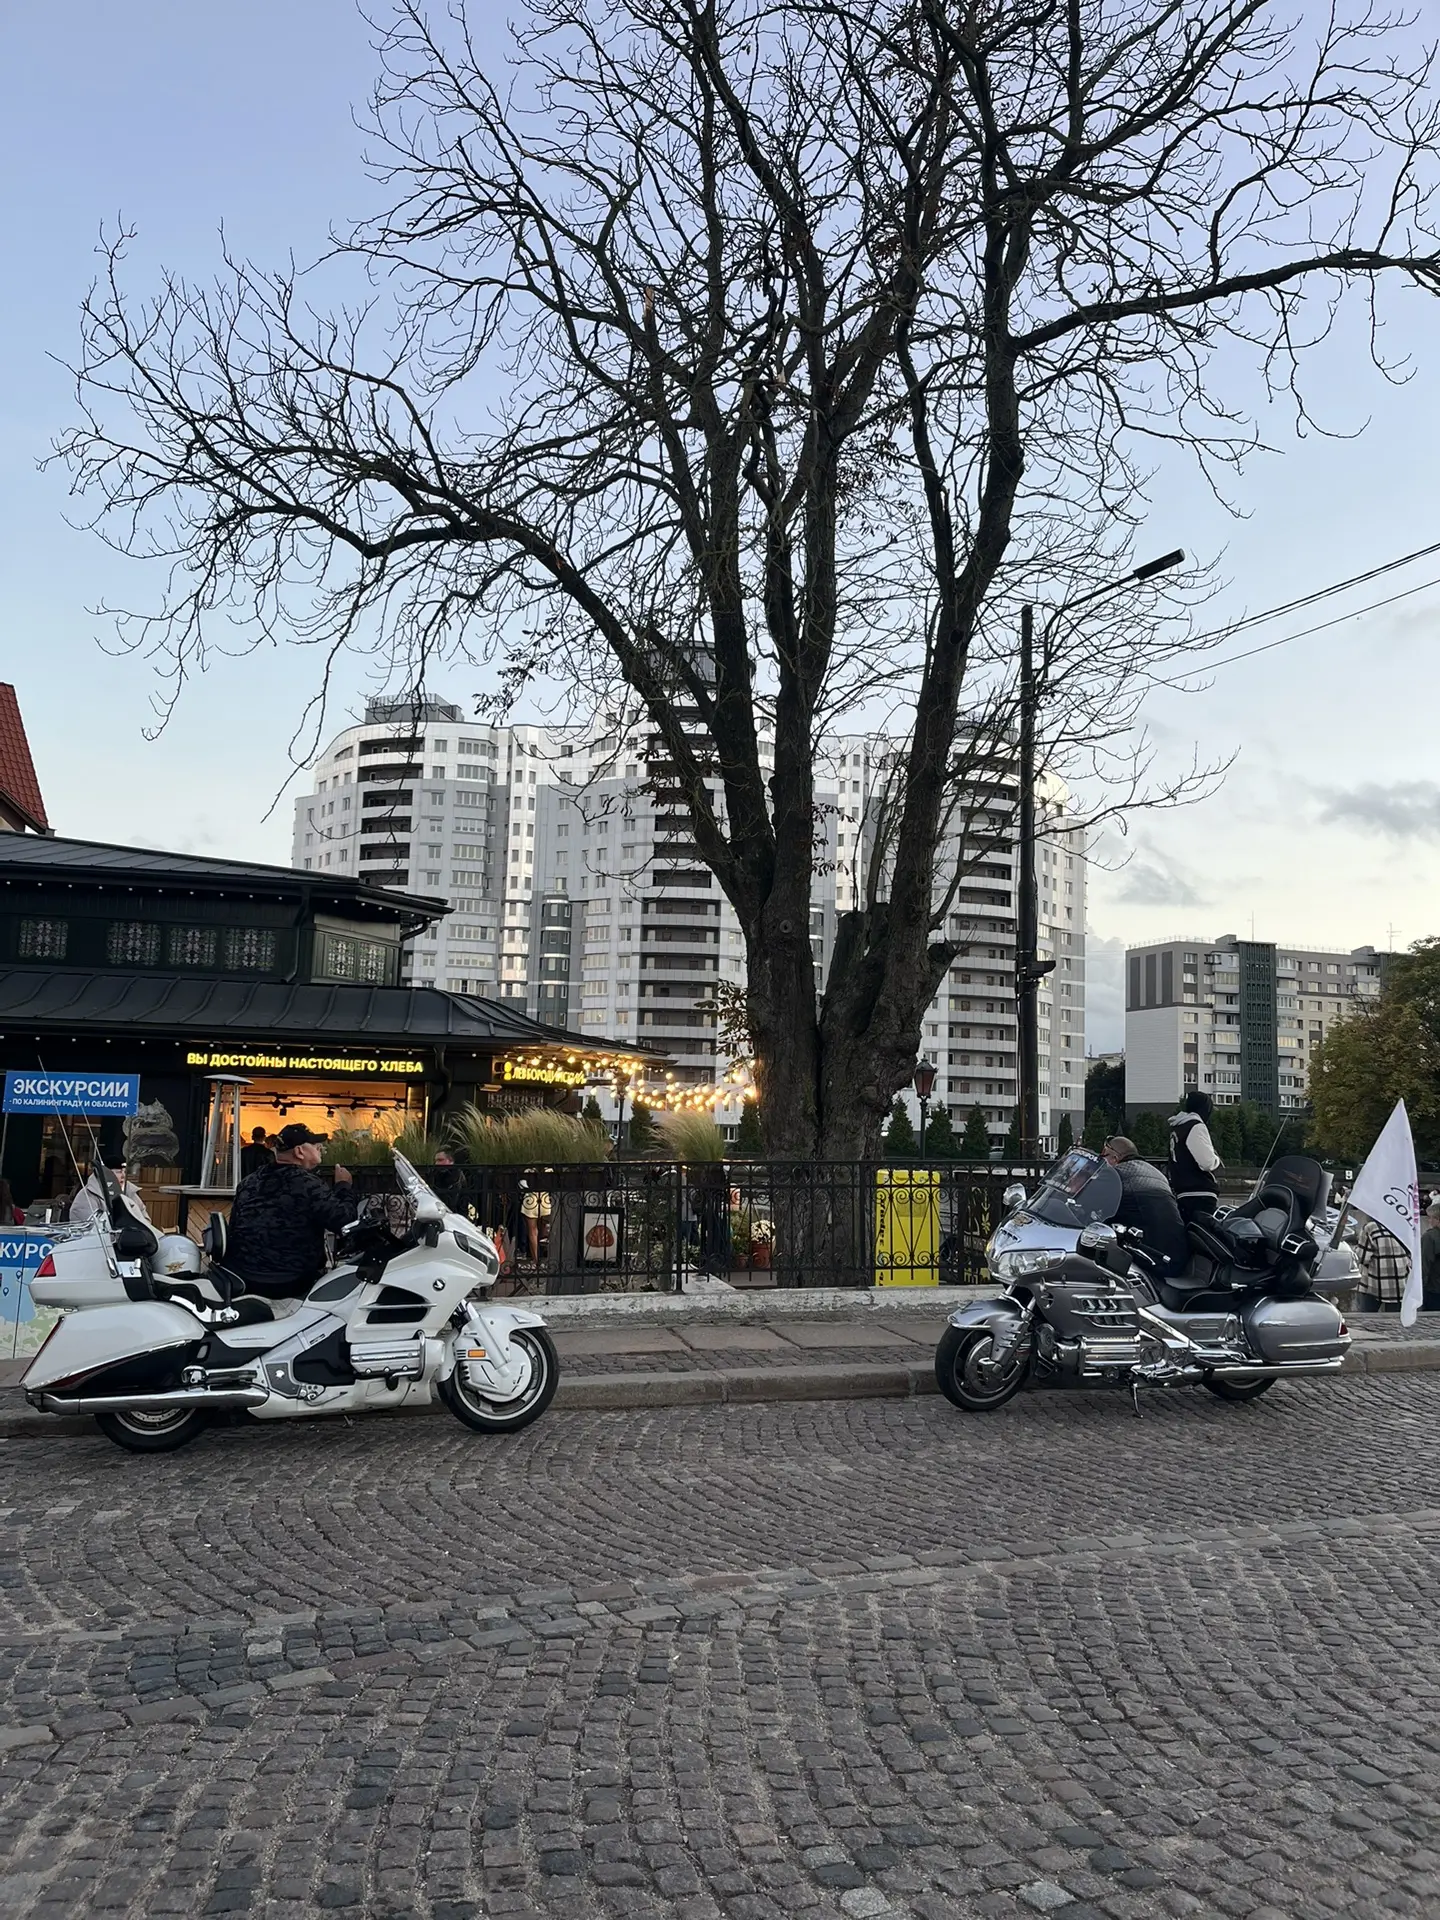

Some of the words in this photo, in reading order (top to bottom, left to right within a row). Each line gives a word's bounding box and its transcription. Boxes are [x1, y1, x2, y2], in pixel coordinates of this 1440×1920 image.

[187, 1053, 208, 1065] ВЫ
[210, 1053, 287, 1068] ДОСТОЙНЫ
[289, 1057, 377, 1072] НАСТОЯЩЕГО
[380, 1061, 423, 1073] ХЛЕБА
[13, 1078, 130, 1098] ЭКСКУРСИИ
[12, 1098, 22, 1106] ПО
[23, 1098, 83, 1108] КАЛИНИНГРАДУ
[91, 1100, 128, 1108] ОБЛАСТИ
[1383, 1194, 1416, 1231] GOL
[0, 1241, 55, 1260] КУРС
